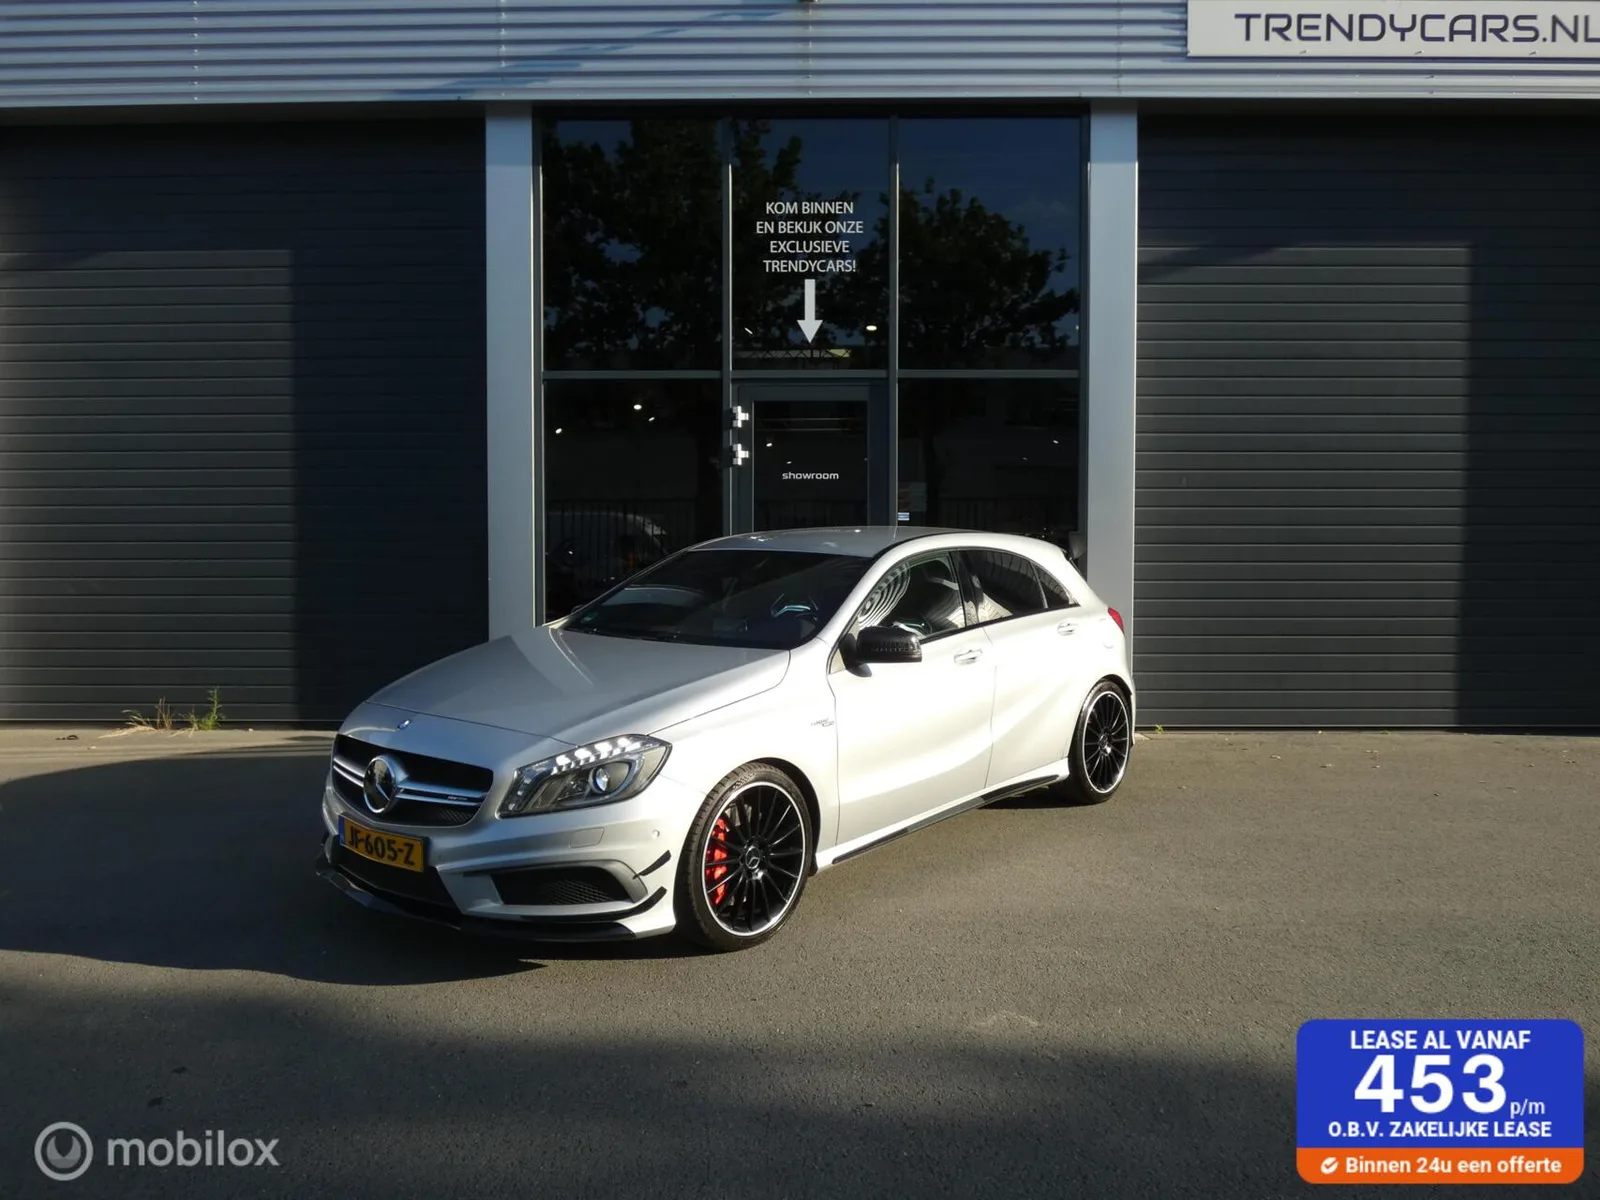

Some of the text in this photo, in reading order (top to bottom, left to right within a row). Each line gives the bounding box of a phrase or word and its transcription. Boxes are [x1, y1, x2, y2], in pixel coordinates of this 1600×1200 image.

[1234, 13, 1600, 43] TRENDYCARS.NL
[766, 201, 854, 215] KOM BINNEN
[756, 220, 864, 235] EN BEKIJK ONZE
[770, 240, 850, 254] EXCLUSIEVE
[763, 259, 857, 273] TRENDYCARS!
[782, 471, 839, 480] showroom
[349, 825, 415, 866] JF-605-Z
